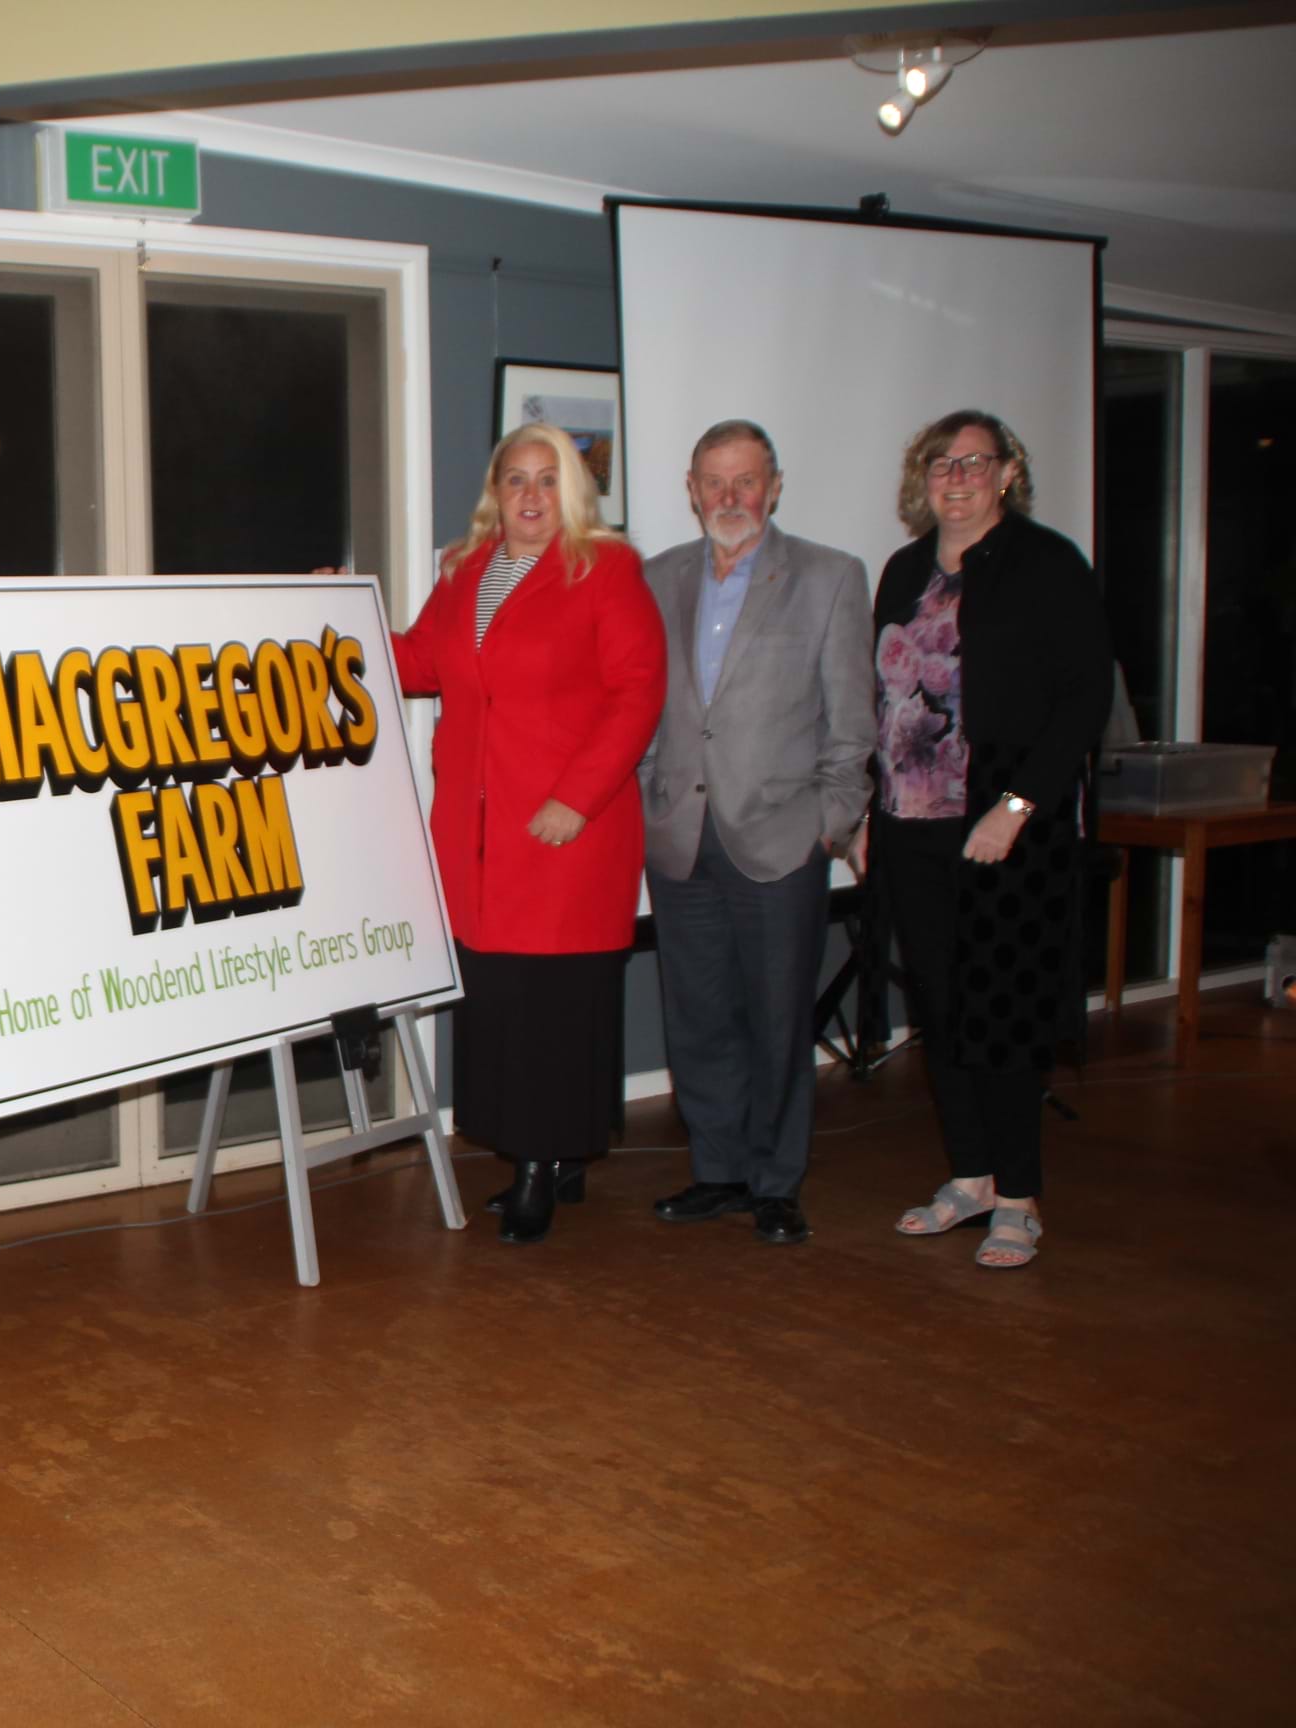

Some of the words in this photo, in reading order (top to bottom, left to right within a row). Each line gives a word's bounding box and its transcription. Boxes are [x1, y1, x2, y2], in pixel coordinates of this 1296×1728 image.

[92, 144, 170, 196] EXIT
[110, 774, 305, 936] FARM
[71, 973, 93, 1020] of
[99, 951, 206, 1013] Woodend
[208, 935, 294, 992] Lifestyle
[296, 930, 359, 970] Carers
[361, 917, 416, 961] Group
